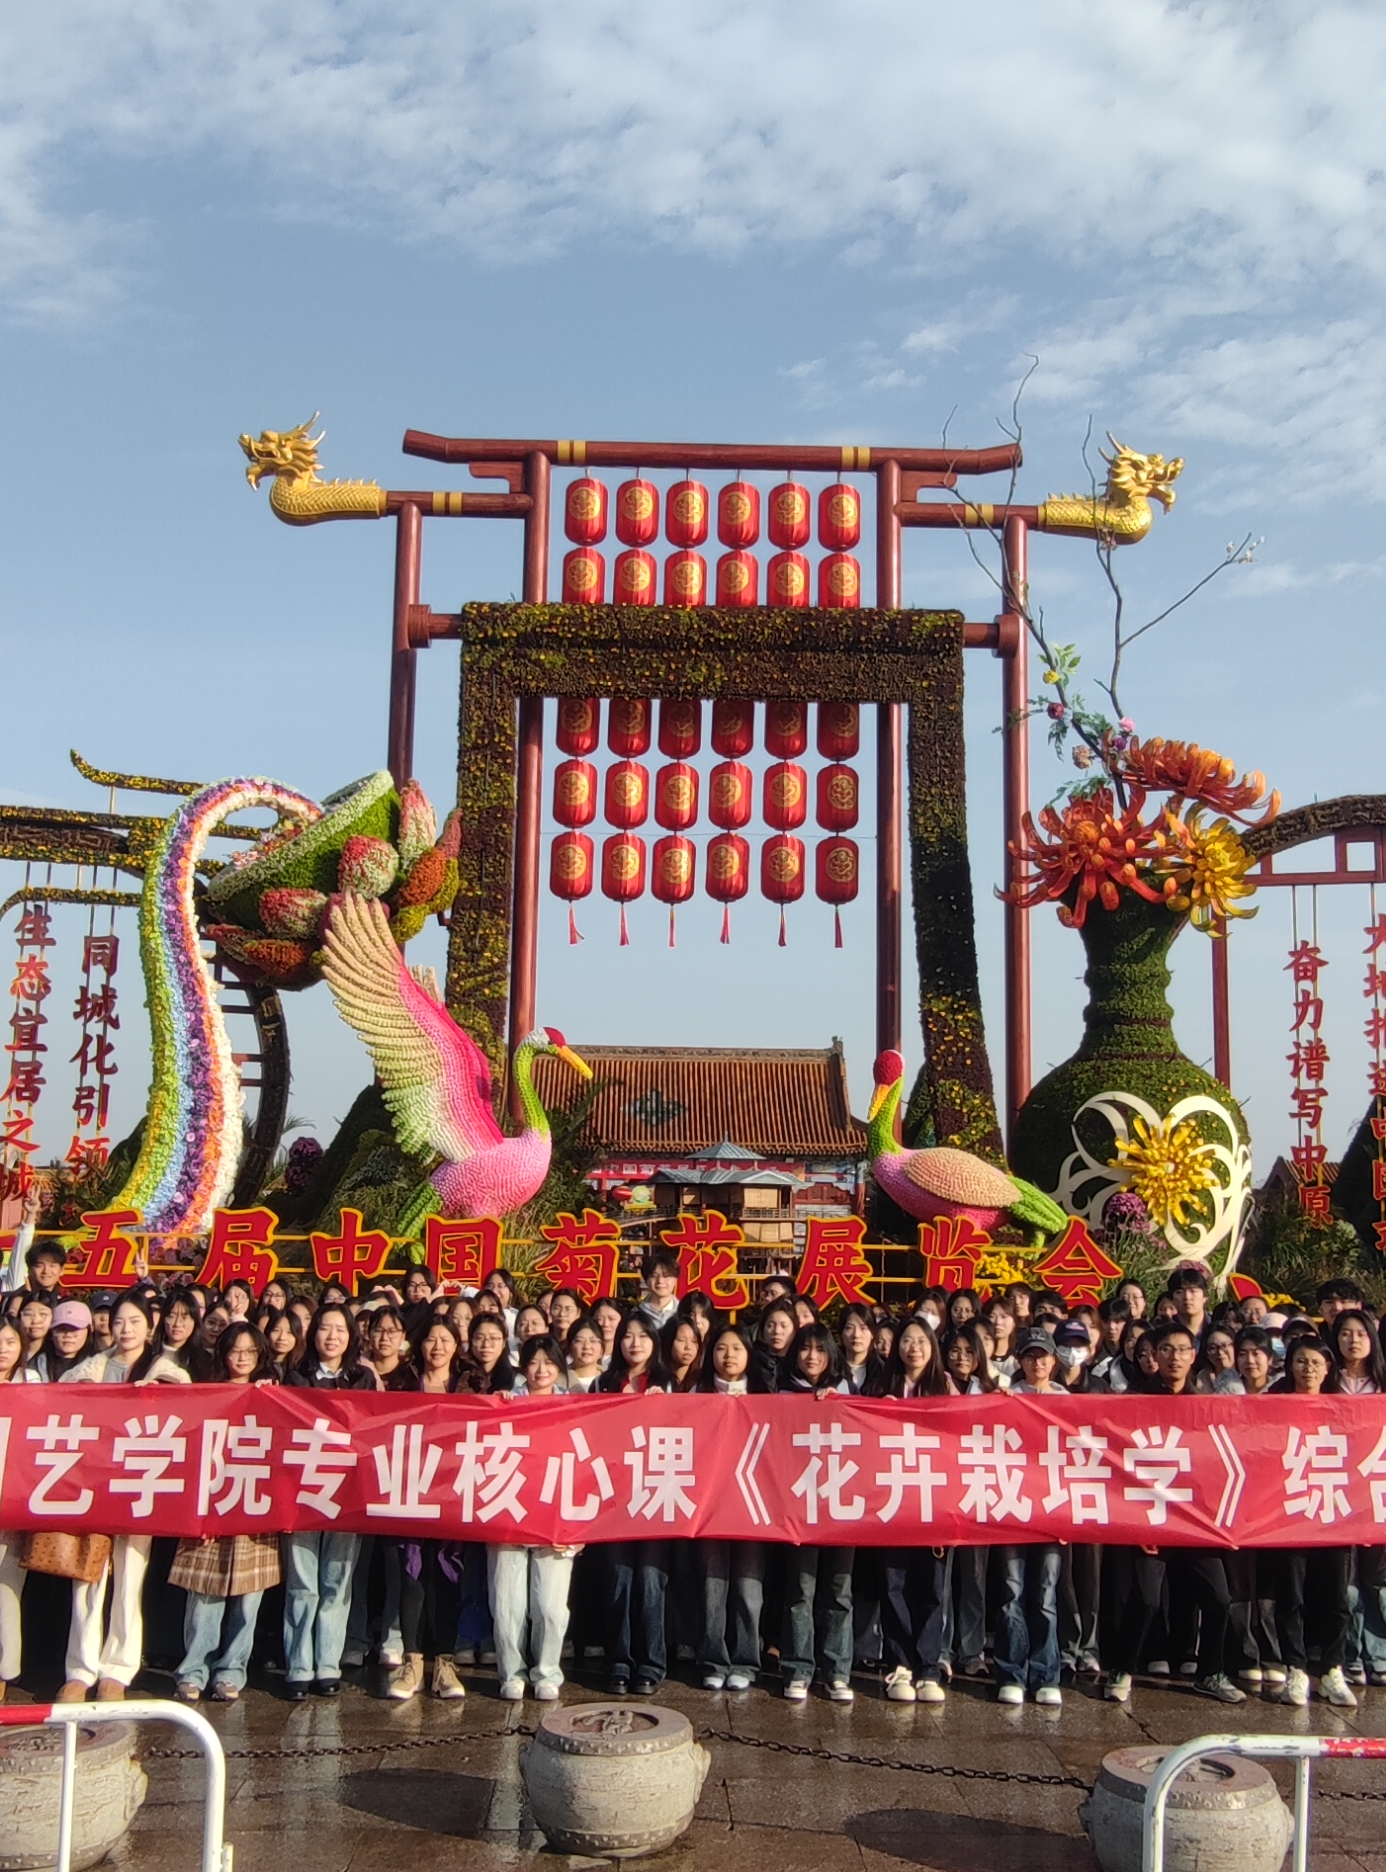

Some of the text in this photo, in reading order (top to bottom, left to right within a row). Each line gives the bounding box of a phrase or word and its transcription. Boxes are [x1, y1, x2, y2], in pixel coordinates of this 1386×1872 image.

[1282, 940, 1334, 1230] 奋力谱写中原
